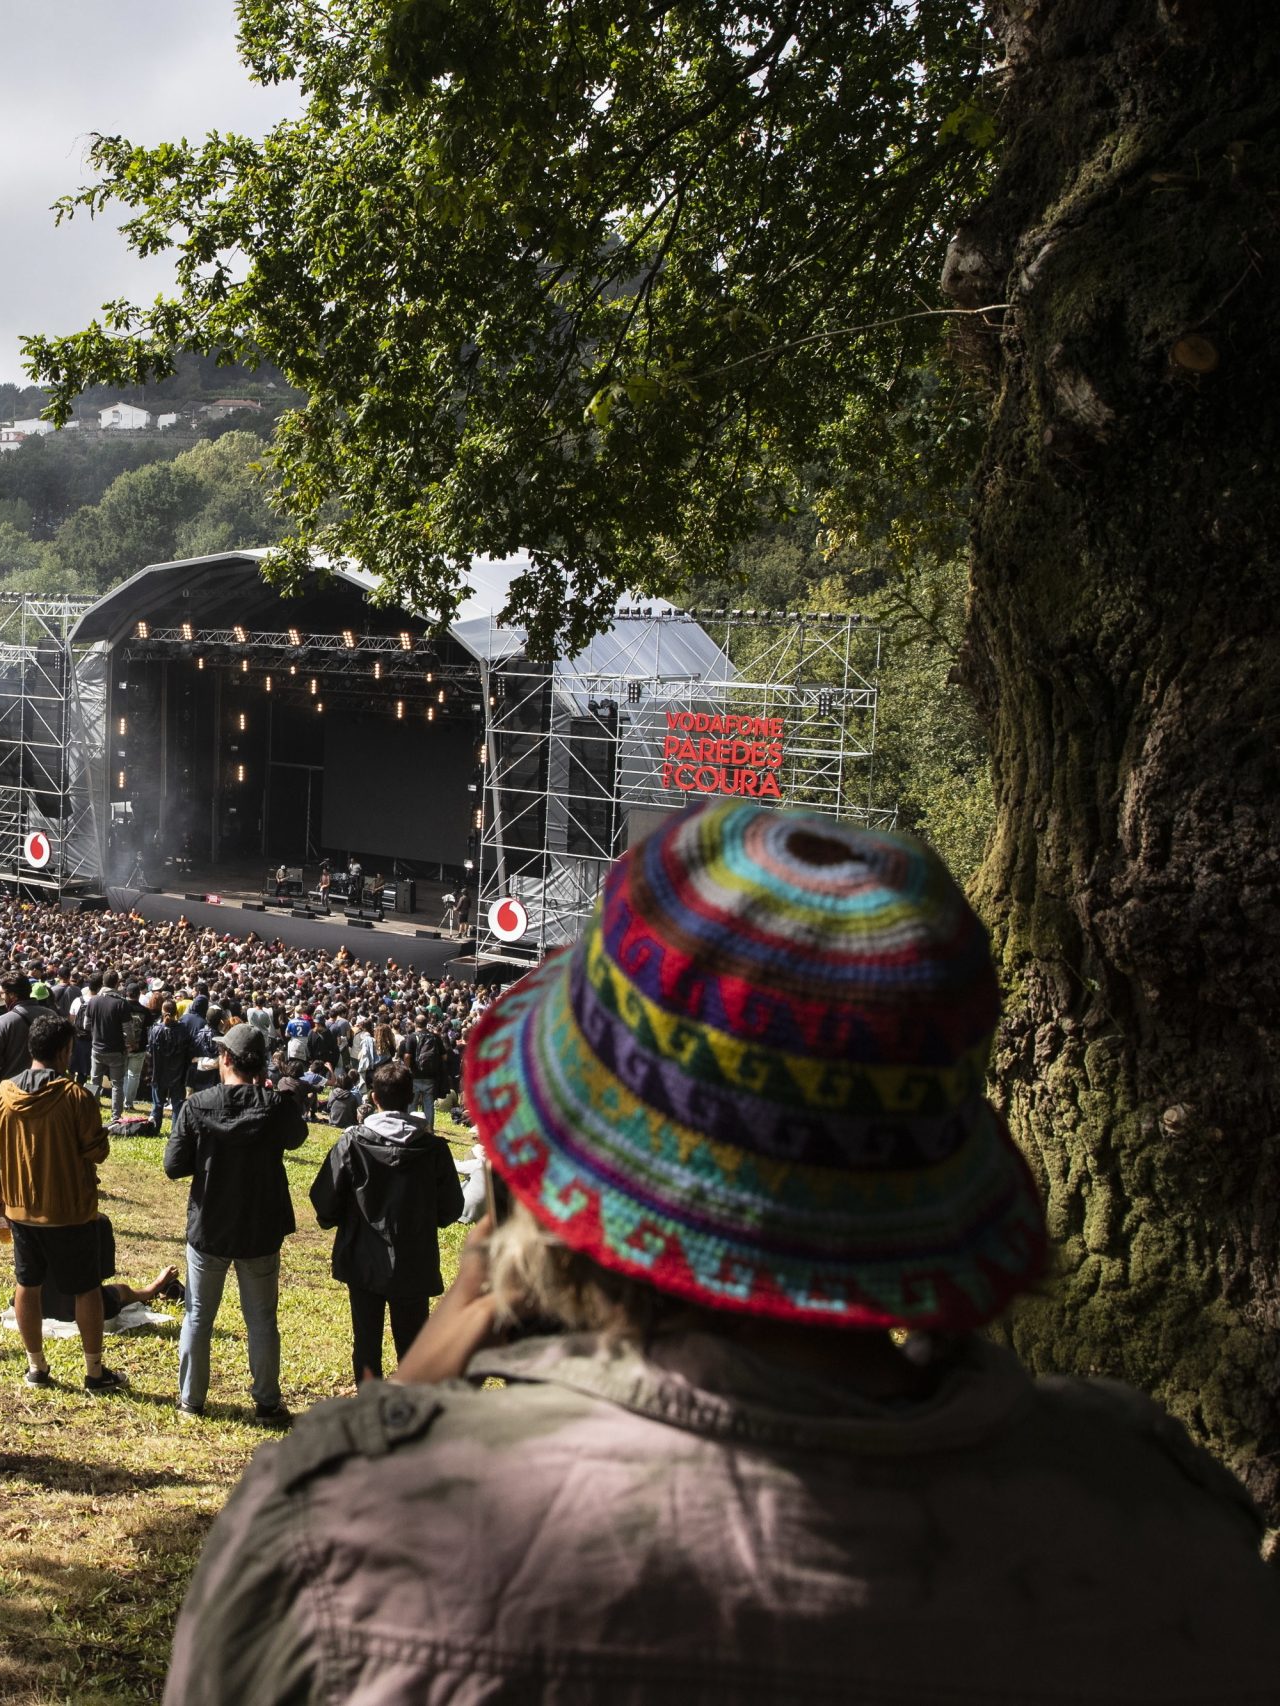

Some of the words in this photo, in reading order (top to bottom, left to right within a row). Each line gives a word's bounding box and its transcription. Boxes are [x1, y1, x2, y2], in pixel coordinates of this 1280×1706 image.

[665, 711, 785, 738] VODAFONE
[664, 735, 784, 768] PAREDES
[673, 763, 782, 799] COURA
